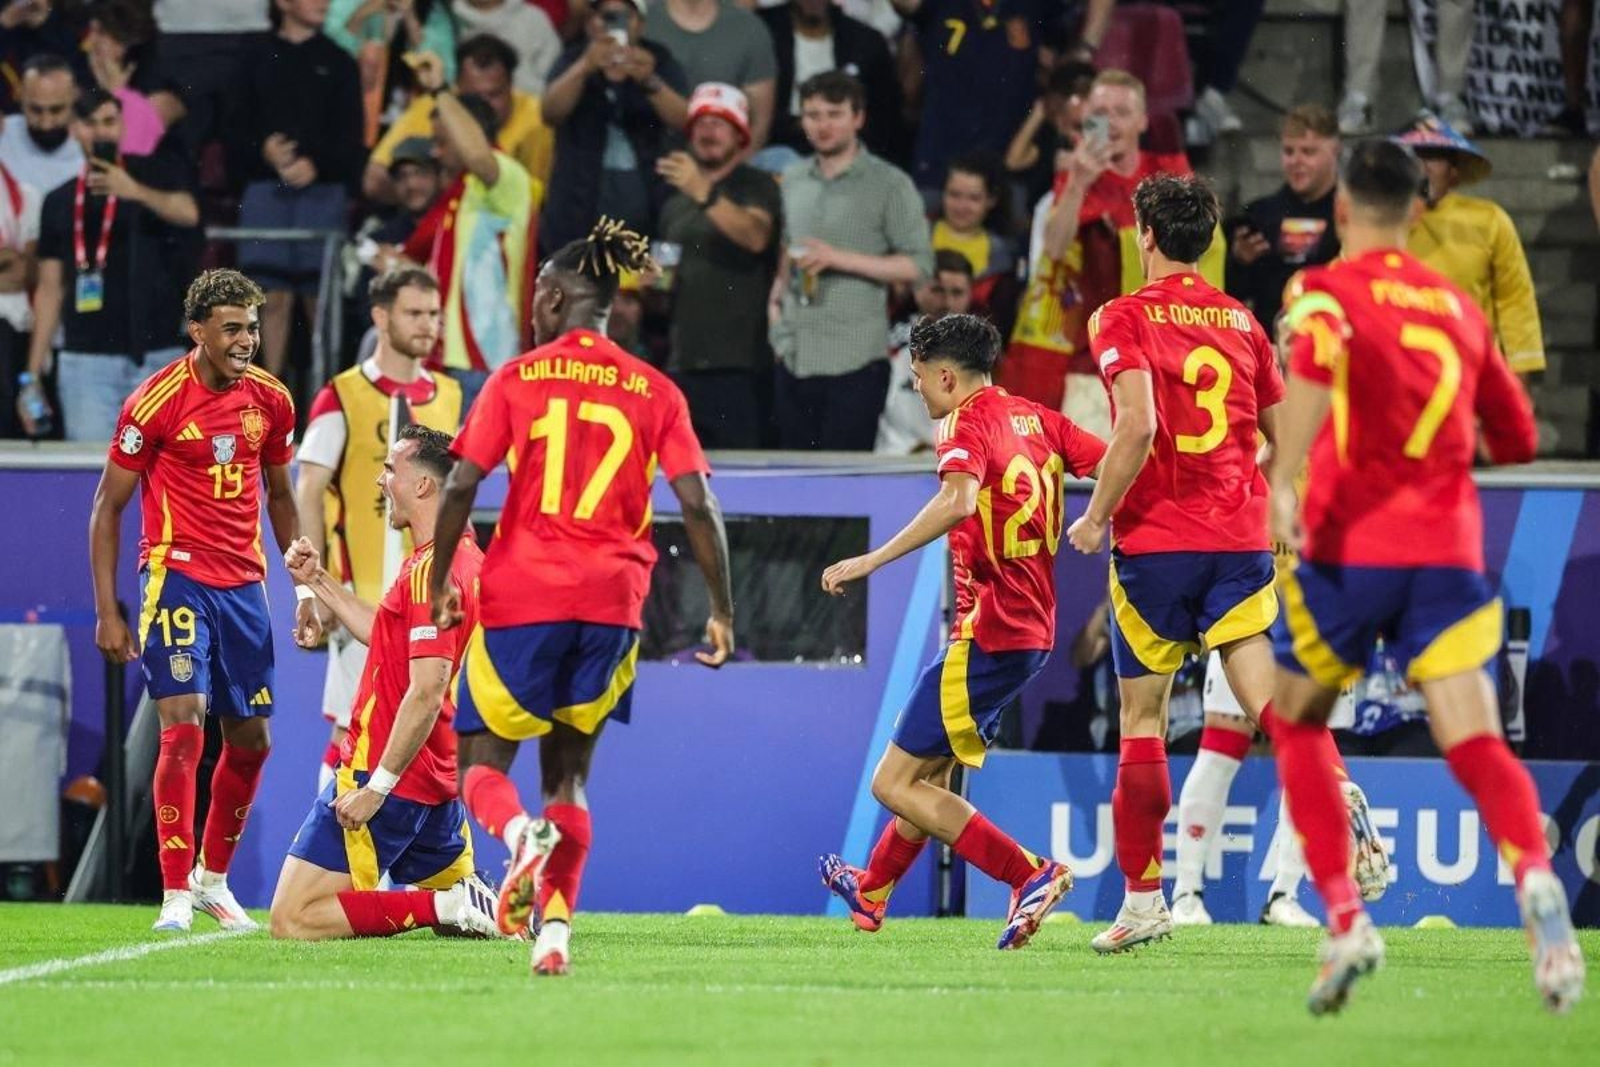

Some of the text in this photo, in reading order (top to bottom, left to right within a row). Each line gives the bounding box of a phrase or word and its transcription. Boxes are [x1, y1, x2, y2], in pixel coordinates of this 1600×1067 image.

[944, 18, 967, 56] 7
[1144, 303, 1252, 333] LE NORMAND
[519, 357, 653, 399] WILLIAMS JR.
[1400, 321, 1463, 460] 7
[1175, 345, 1233, 454] 3
[529, 397, 634, 520] 17
[207, 463, 244, 499] 19
[1002, 453, 1065, 560] 20
[156, 606, 196, 647] 19
